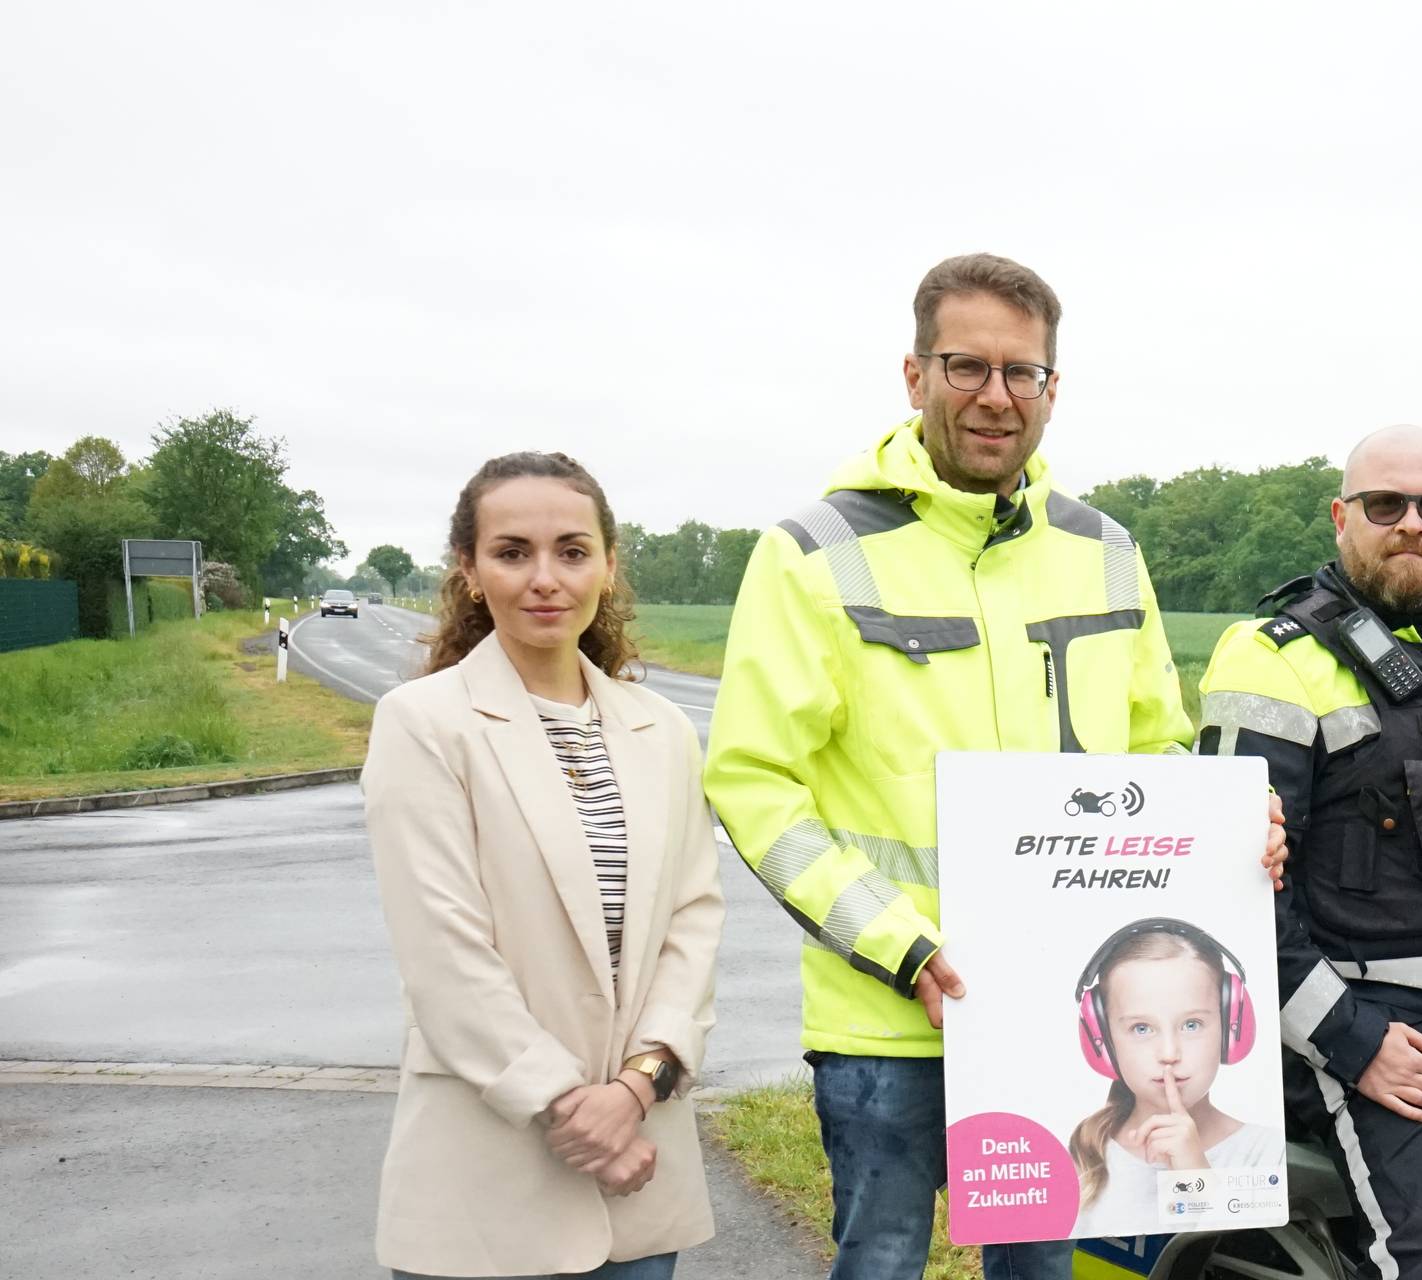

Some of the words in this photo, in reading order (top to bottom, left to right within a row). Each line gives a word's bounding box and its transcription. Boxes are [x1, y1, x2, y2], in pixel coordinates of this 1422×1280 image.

[1014, 835, 1098, 856] BITTE
[1104, 835, 1195, 857] LEISE
[1052, 868, 1171, 889] FAHREN!
[981, 1136, 1031, 1155] Denk
[962, 1168, 986, 1182] an
[991, 1161, 1051, 1181] MEINE
[967, 1187, 1048, 1208] Zukunft!
